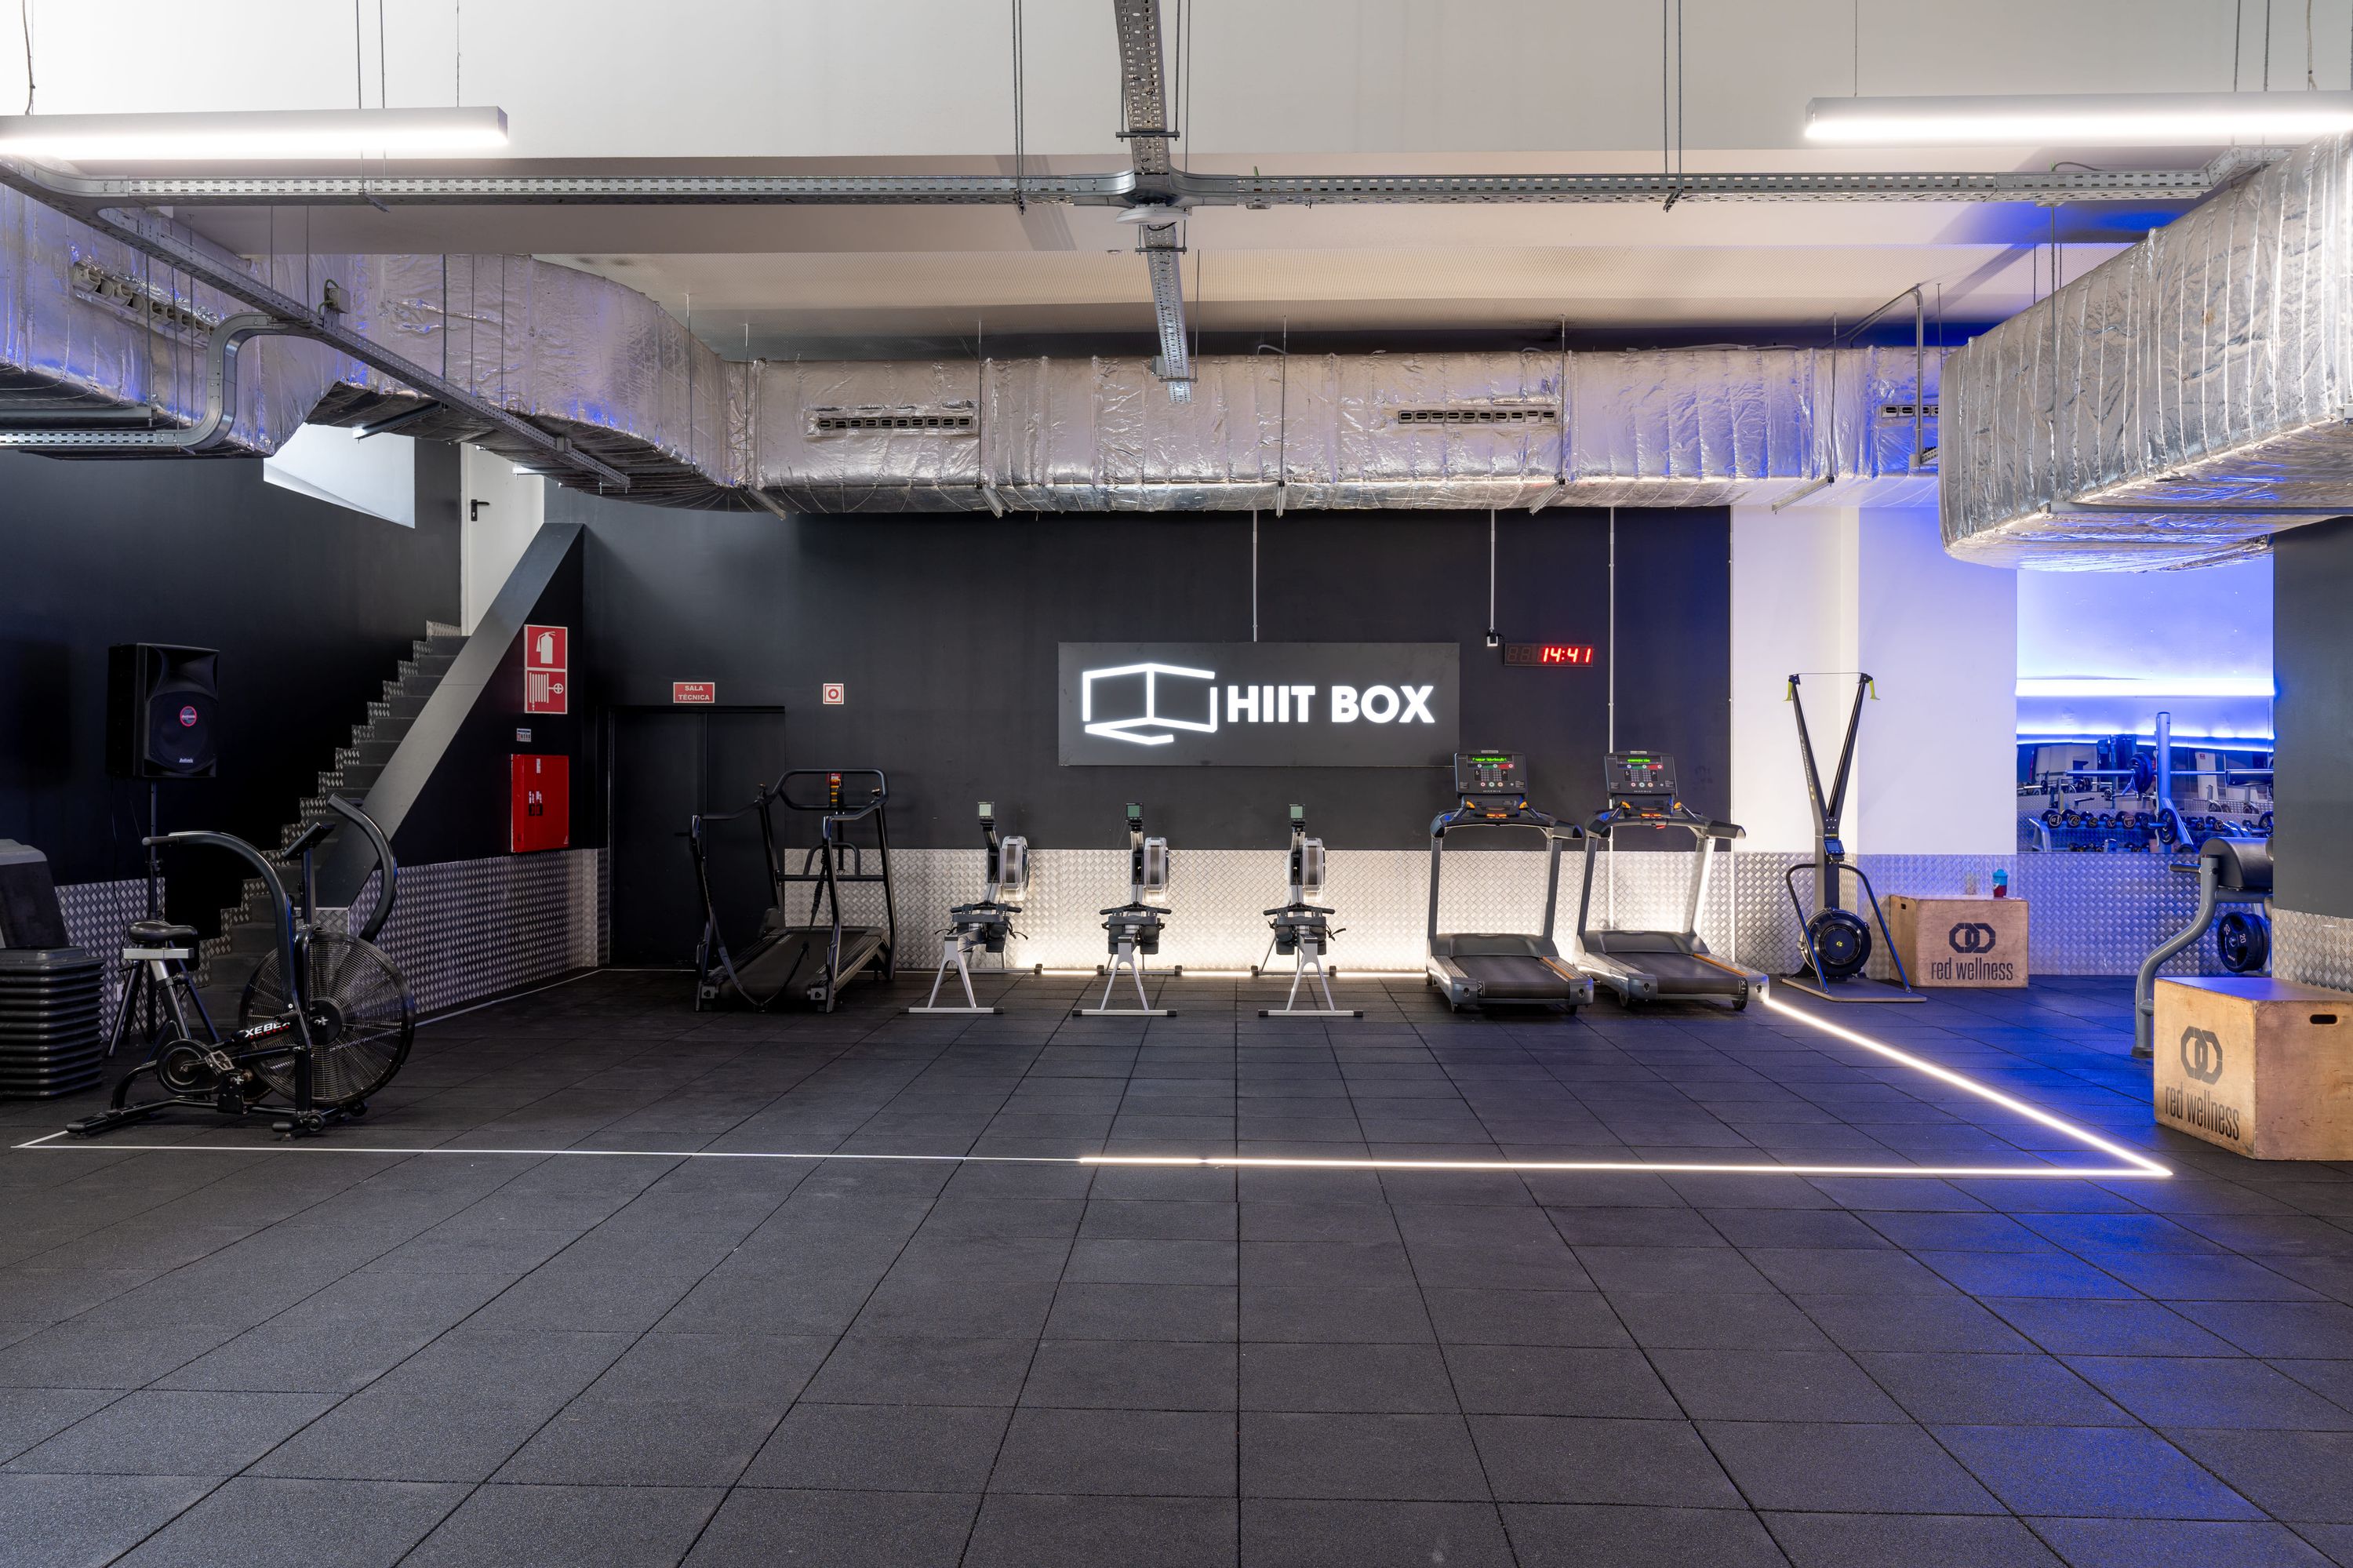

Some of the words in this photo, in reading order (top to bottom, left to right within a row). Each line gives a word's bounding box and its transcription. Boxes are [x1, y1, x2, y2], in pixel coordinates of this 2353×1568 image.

[1542, 647, 1591, 663] 14:41
[1227, 685, 1316, 723] HIIT
[1331, 685, 1436, 724] BOX
[2239, 933, 2246, 944] 20
[1931, 957, 1952, 980] red
[1956, 957, 2013, 980] wellness
[2166, 1081, 2183, 1120] red
[2187, 1090, 2239, 1141] wellness
